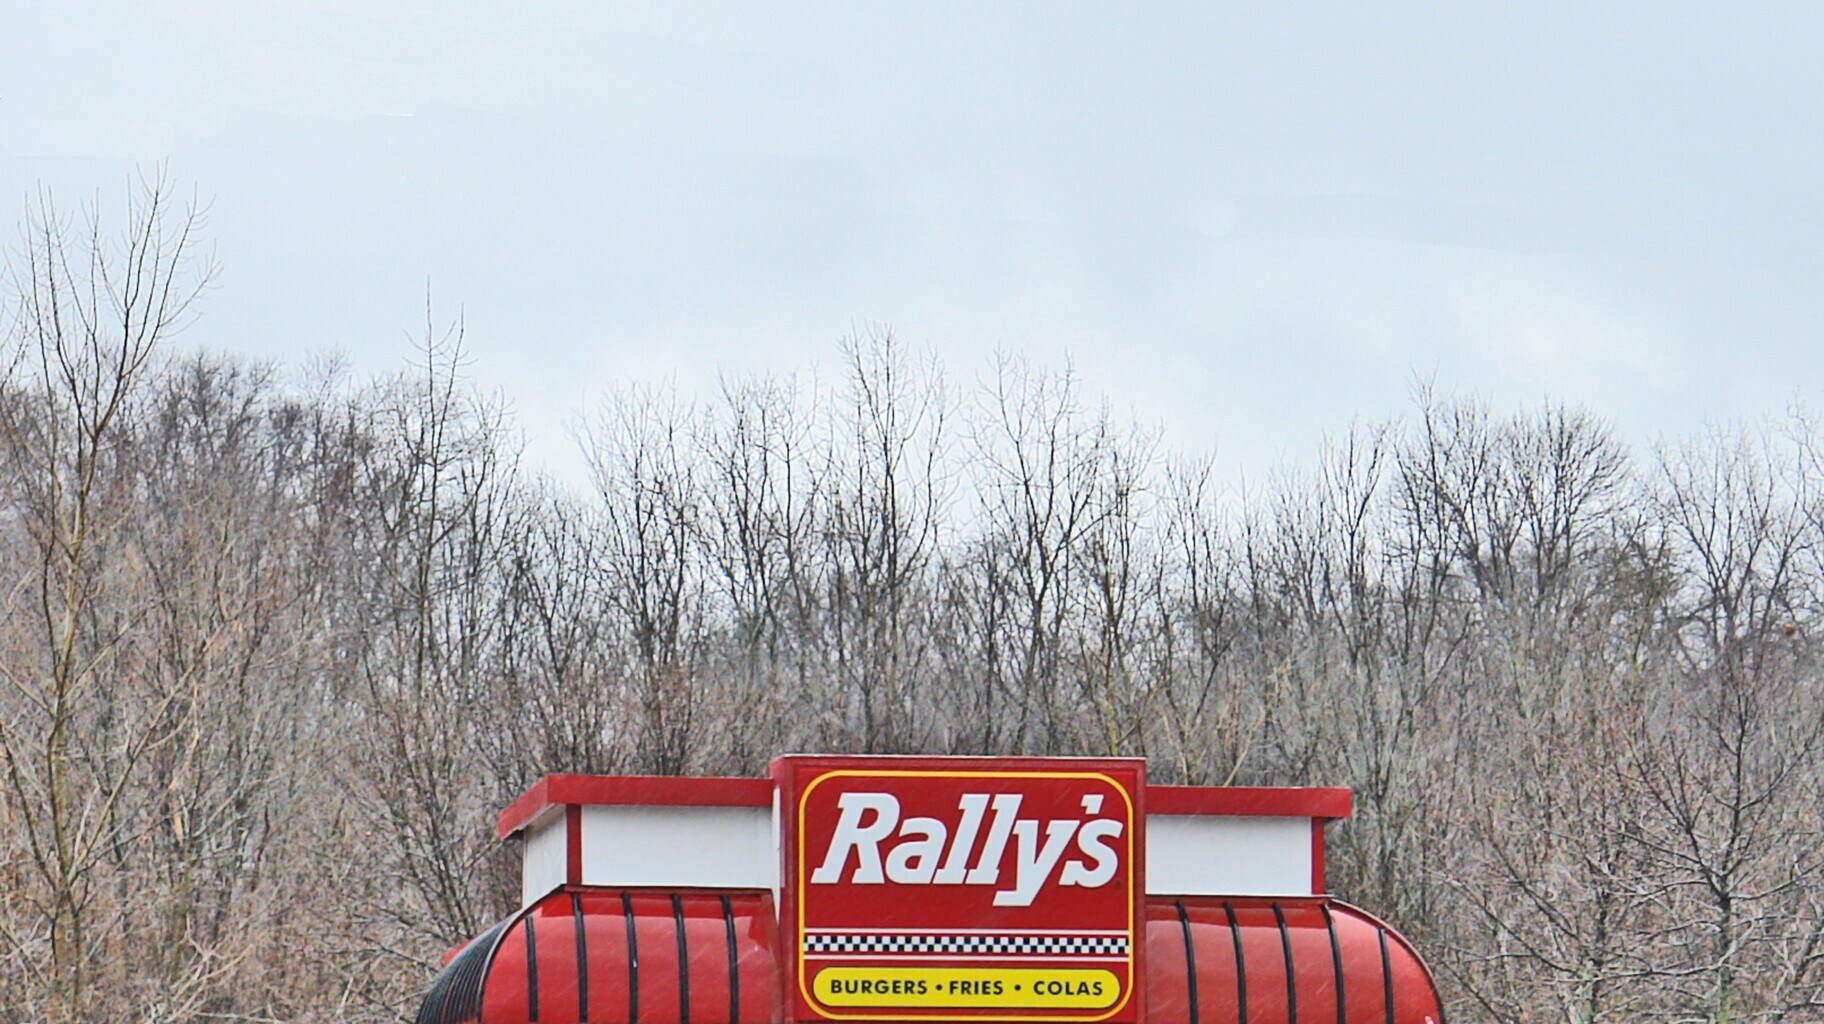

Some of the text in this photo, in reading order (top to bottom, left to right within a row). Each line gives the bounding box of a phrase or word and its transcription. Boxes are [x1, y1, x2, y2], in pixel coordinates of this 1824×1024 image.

[810, 792, 1124, 907] Rally's
[830, 979, 1104, 996] BURGERS FRIES COLAS
